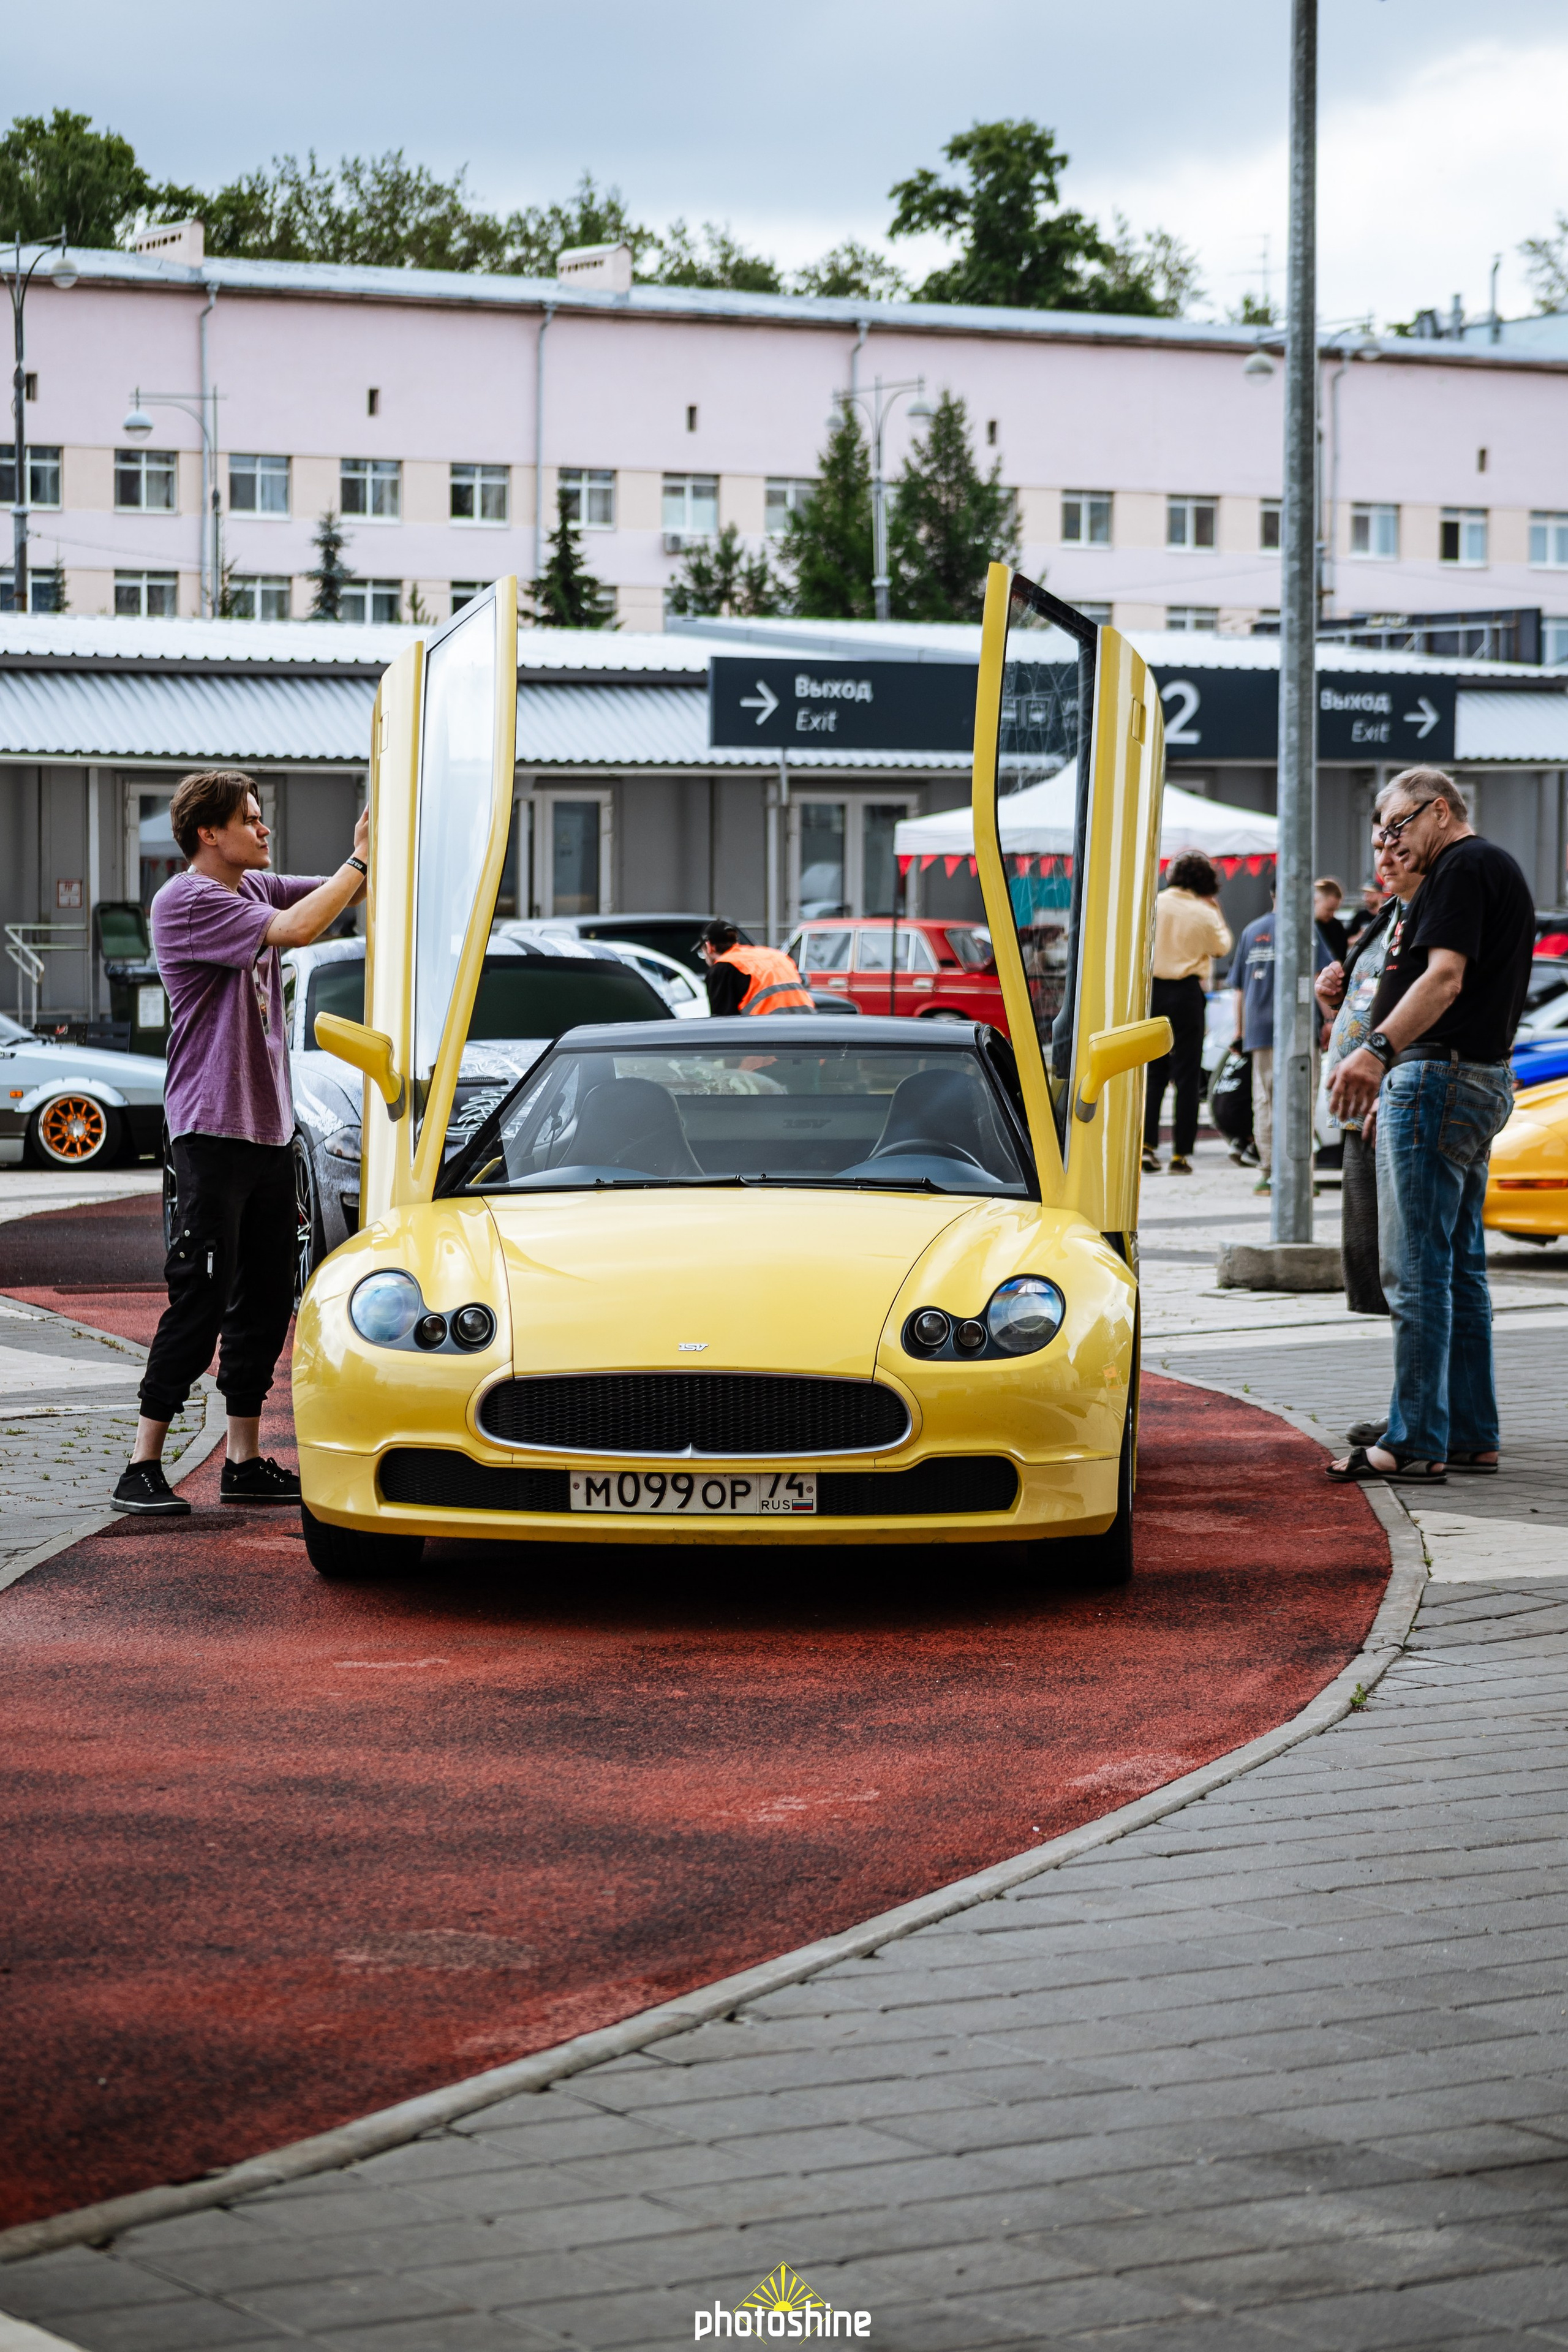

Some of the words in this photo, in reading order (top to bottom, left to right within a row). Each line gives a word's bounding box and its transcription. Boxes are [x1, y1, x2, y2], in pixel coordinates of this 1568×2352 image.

[795, 674, 873, 703] Выход
[1320, 687, 1392, 715] Выход
[796, 707, 838, 732] Exit
[1161, 679, 1201, 745] 2
[1351, 719, 1392, 743] Exit
[766, 1472, 804, 1498] 74
[761, 1499, 791, 1510] RUS
